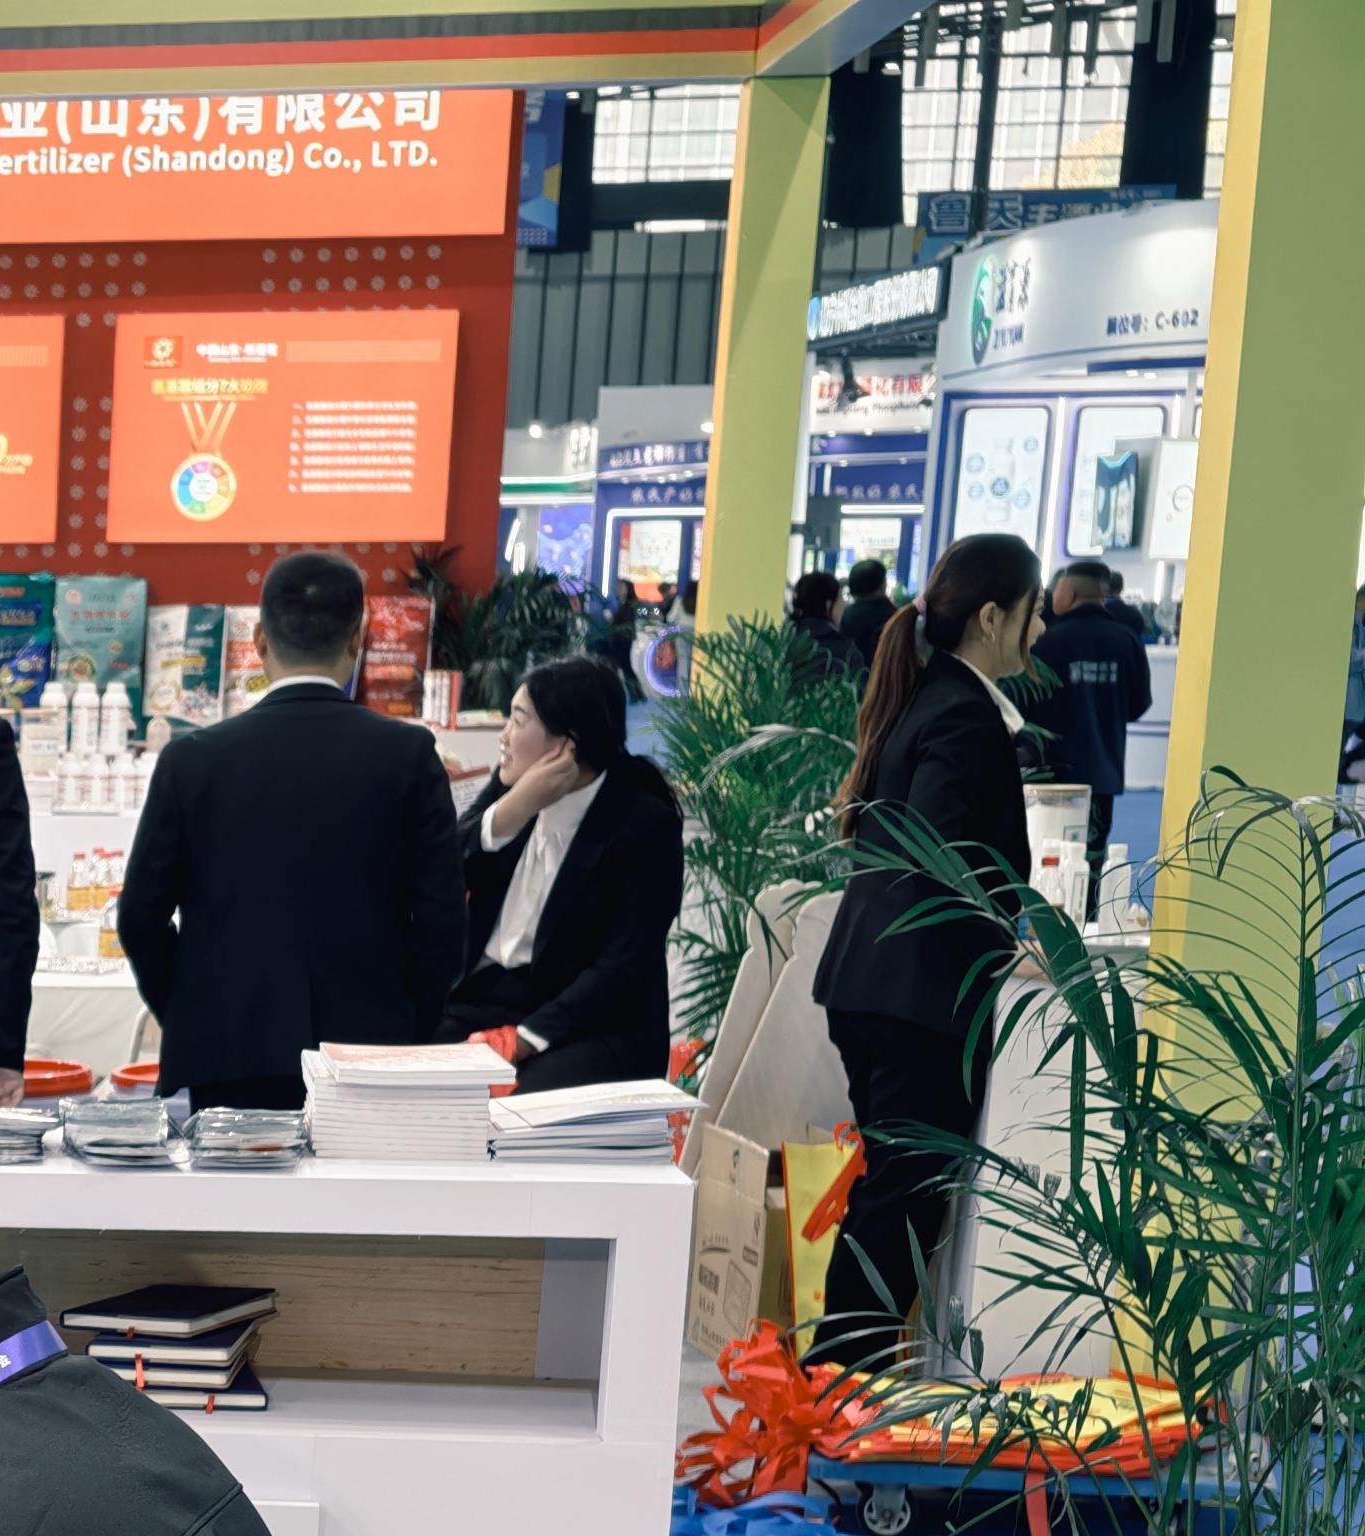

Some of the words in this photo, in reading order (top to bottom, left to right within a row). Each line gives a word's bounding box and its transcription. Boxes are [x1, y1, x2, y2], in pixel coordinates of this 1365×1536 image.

[123, 141, 294, 178] (Shandong)
[304, 142, 362, 173] Co.,
[372, 139, 437, 168] LTD.
